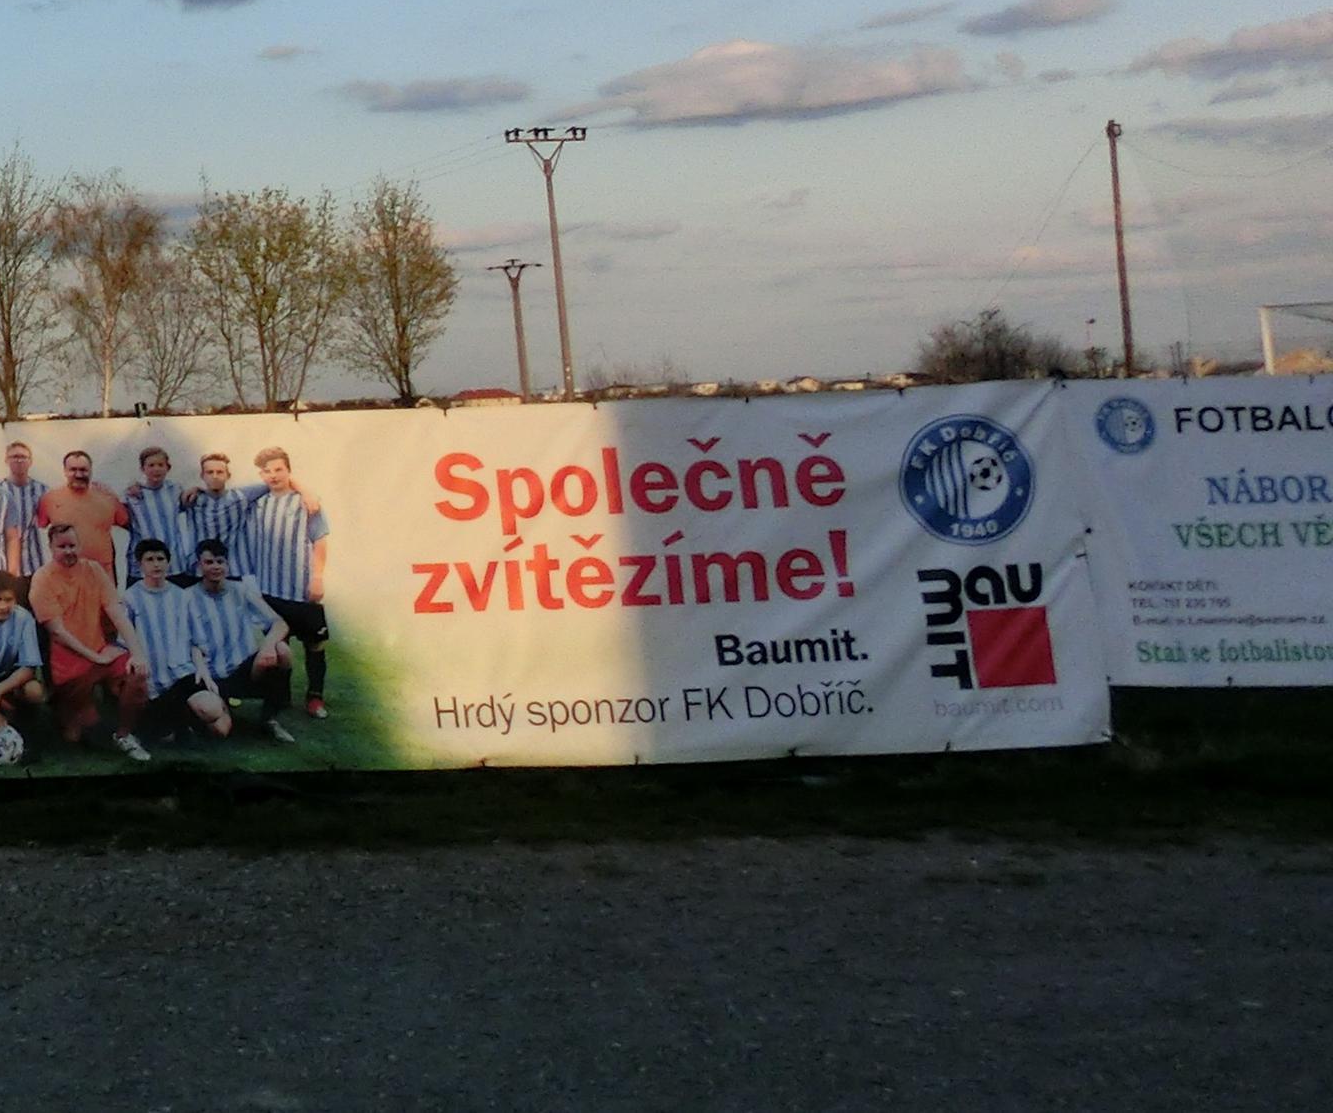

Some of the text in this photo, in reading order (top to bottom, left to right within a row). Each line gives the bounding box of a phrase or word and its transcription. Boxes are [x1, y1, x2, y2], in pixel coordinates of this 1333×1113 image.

[434, 432, 847, 536] Společně
[1204, 468, 1333, 505] NÁBOR
[950, 519, 999, 538] 1940
[1172, 516, 1284, 549] VŠECH
[411, 529, 856, 614] zvítězíme!
[714, 629, 869, 667] Baumit.
[433, 679, 875, 735] Hrdý sponzor FK Dobříč.
